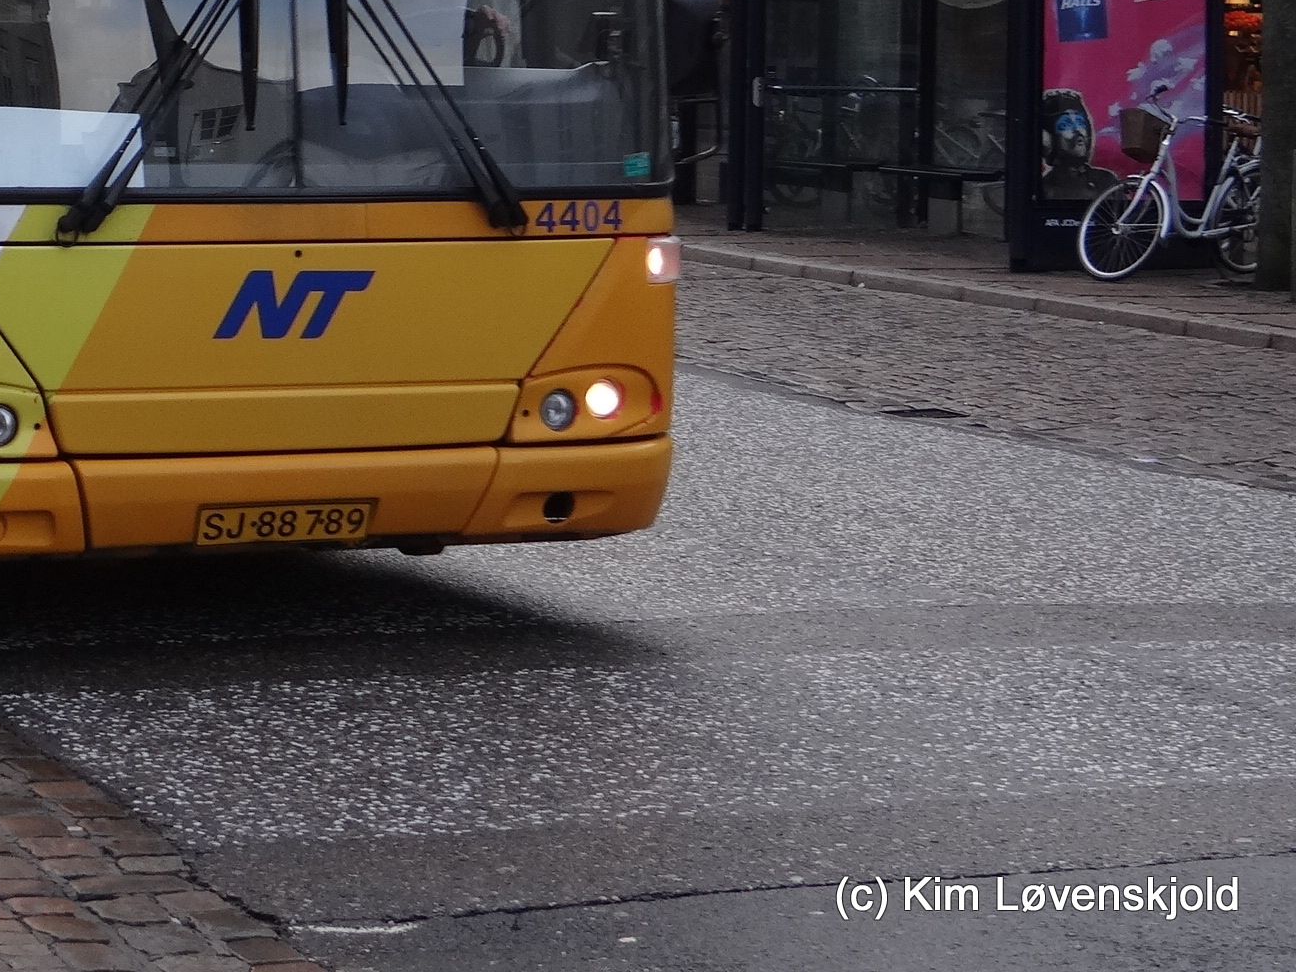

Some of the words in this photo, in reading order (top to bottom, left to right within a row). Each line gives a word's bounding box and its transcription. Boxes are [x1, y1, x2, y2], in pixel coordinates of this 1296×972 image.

[535, 201, 624, 232] 4404
[212, 270, 376, 339] NT
[202, 512, 246, 541] SJ
[255, 510, 298, 538] 88
[305, 508, 366, 536] 789
